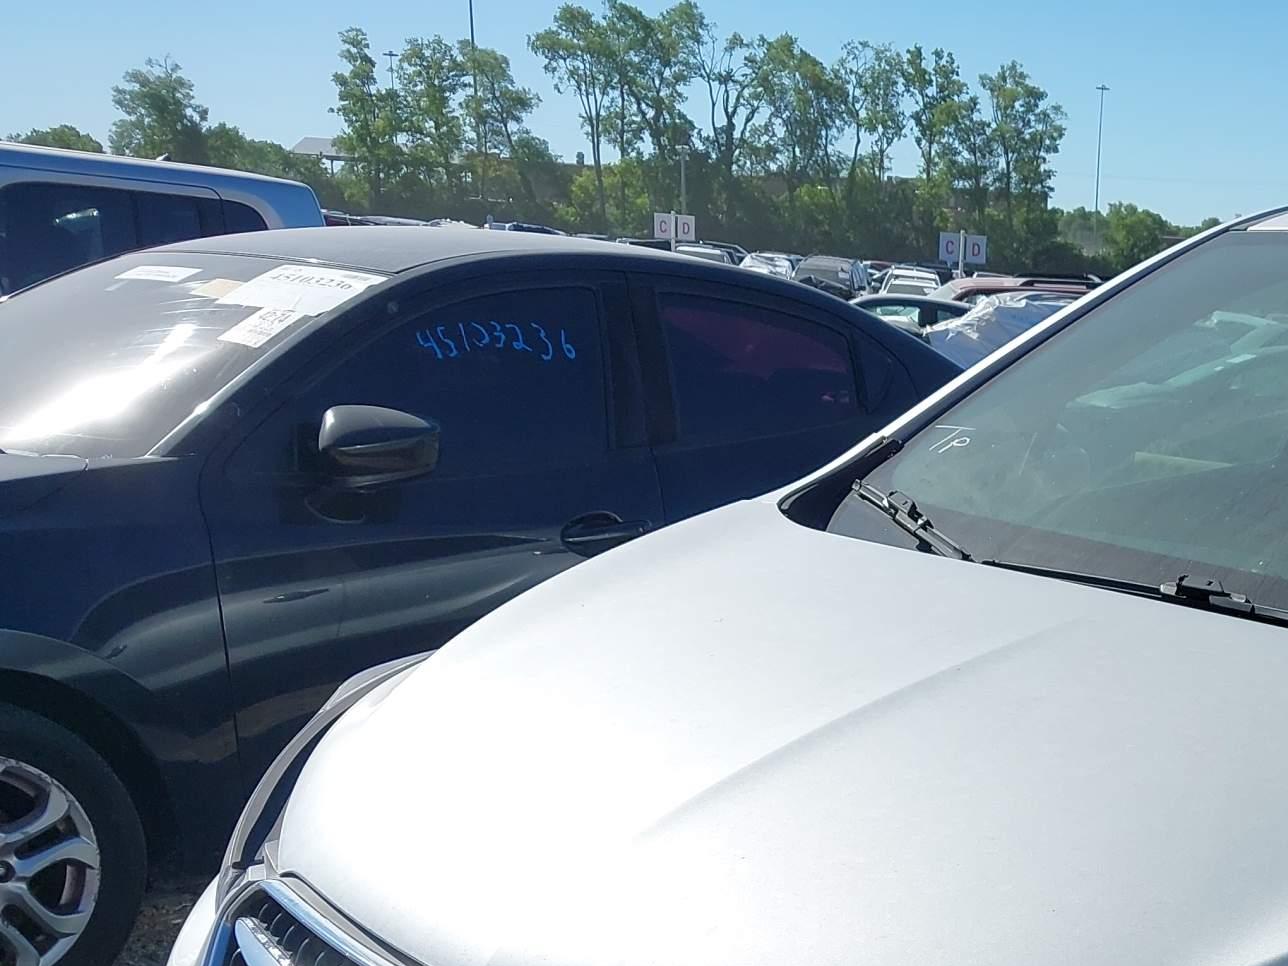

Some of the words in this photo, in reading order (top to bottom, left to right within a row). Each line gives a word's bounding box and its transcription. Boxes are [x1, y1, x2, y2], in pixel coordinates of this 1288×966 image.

[659, 221, 668, 234] C
[681, 222, 691, 235] D
[945, 240, 955, 255] C
[971, 242, 981, 257] D
